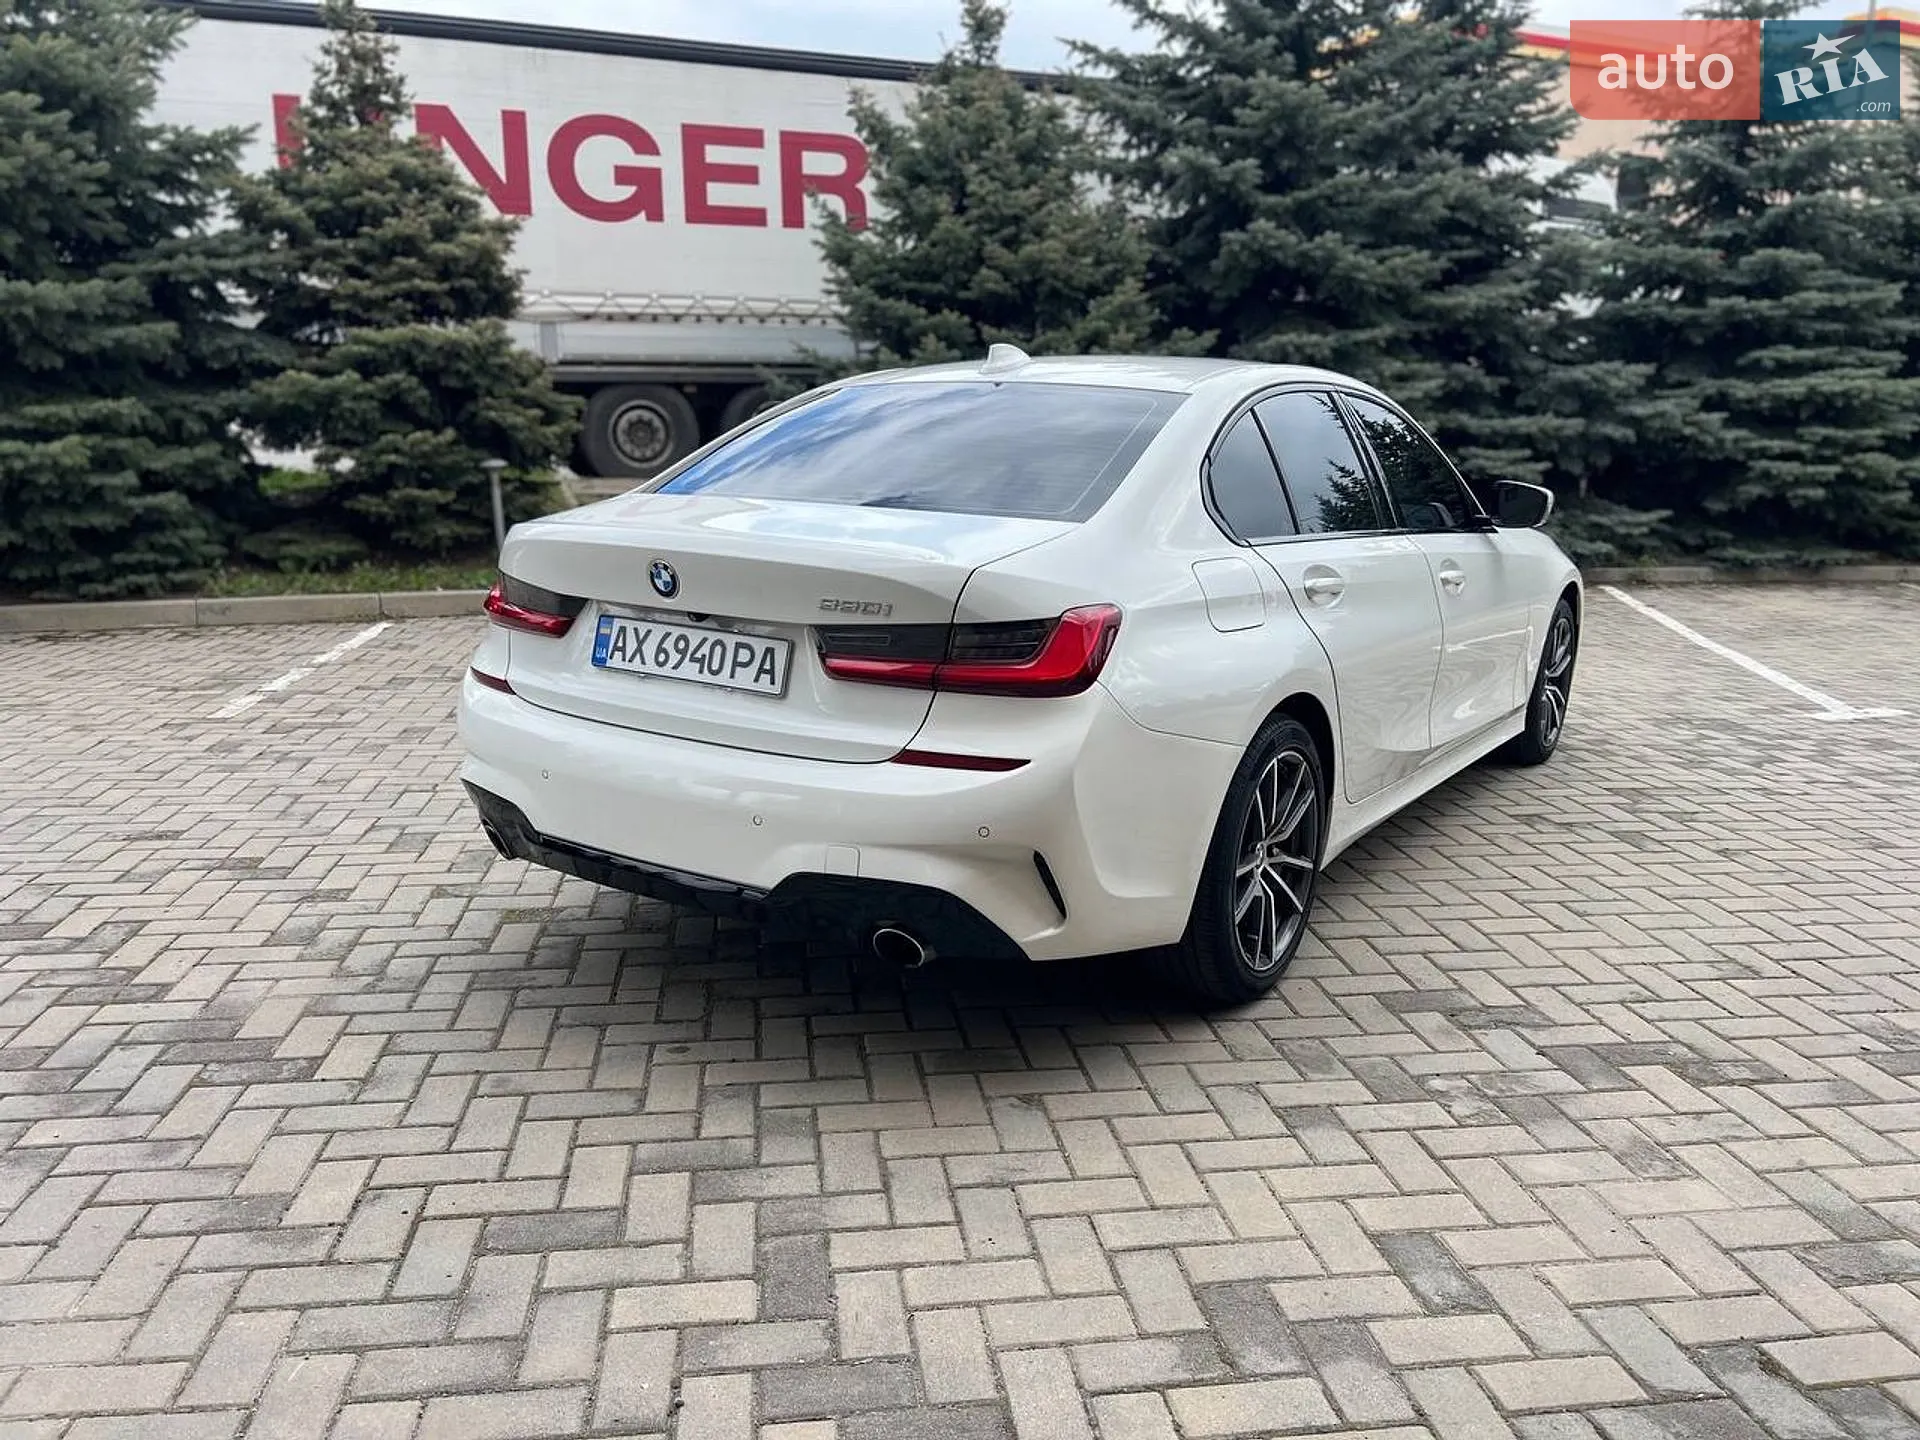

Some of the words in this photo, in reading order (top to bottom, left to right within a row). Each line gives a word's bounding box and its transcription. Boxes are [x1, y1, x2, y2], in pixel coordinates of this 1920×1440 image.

[609, 625, 653, 666] AX
[654, 631, 727, 676] 6940
[730, 641, 776, 685] PA
